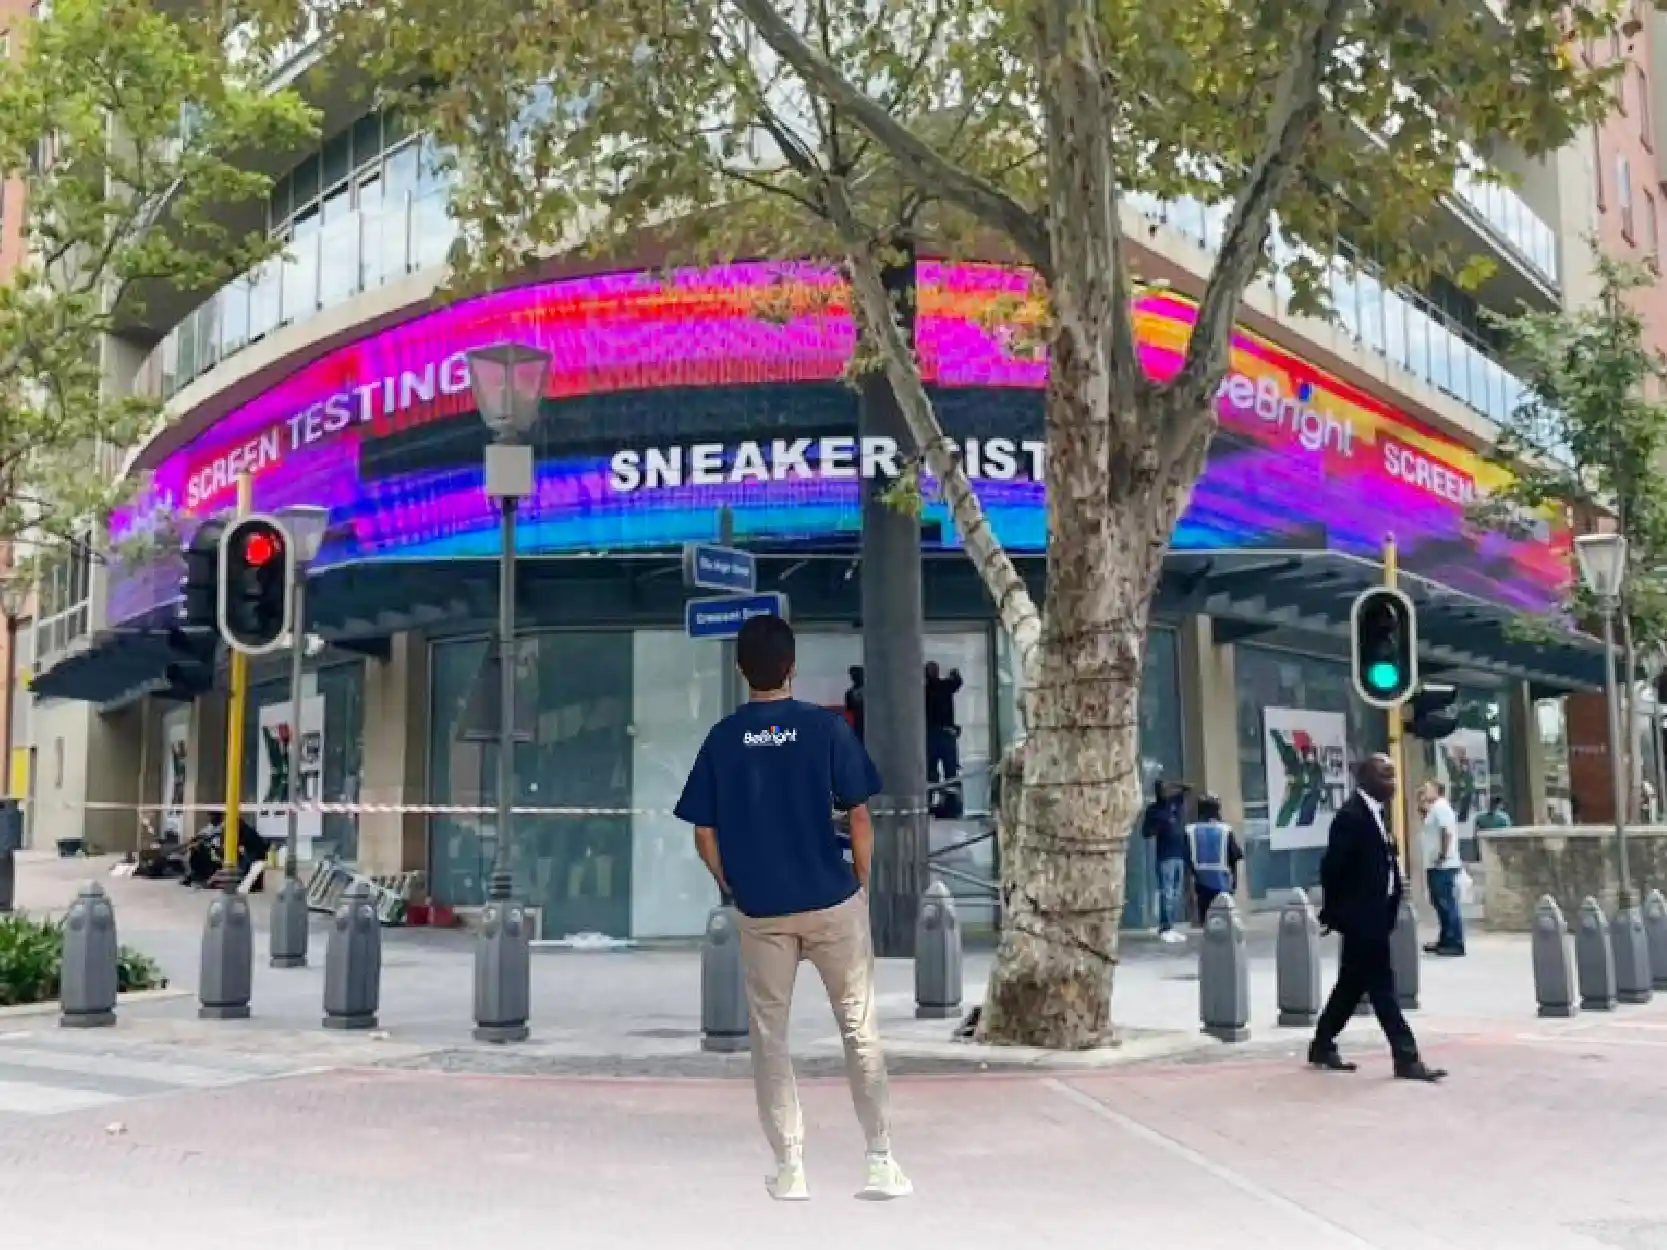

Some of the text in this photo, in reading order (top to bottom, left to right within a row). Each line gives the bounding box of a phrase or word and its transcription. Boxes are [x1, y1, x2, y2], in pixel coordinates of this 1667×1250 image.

[187, 350, 472, 507] SCREEN TESTING
[609, 436, 899, 492] SNEAKER
